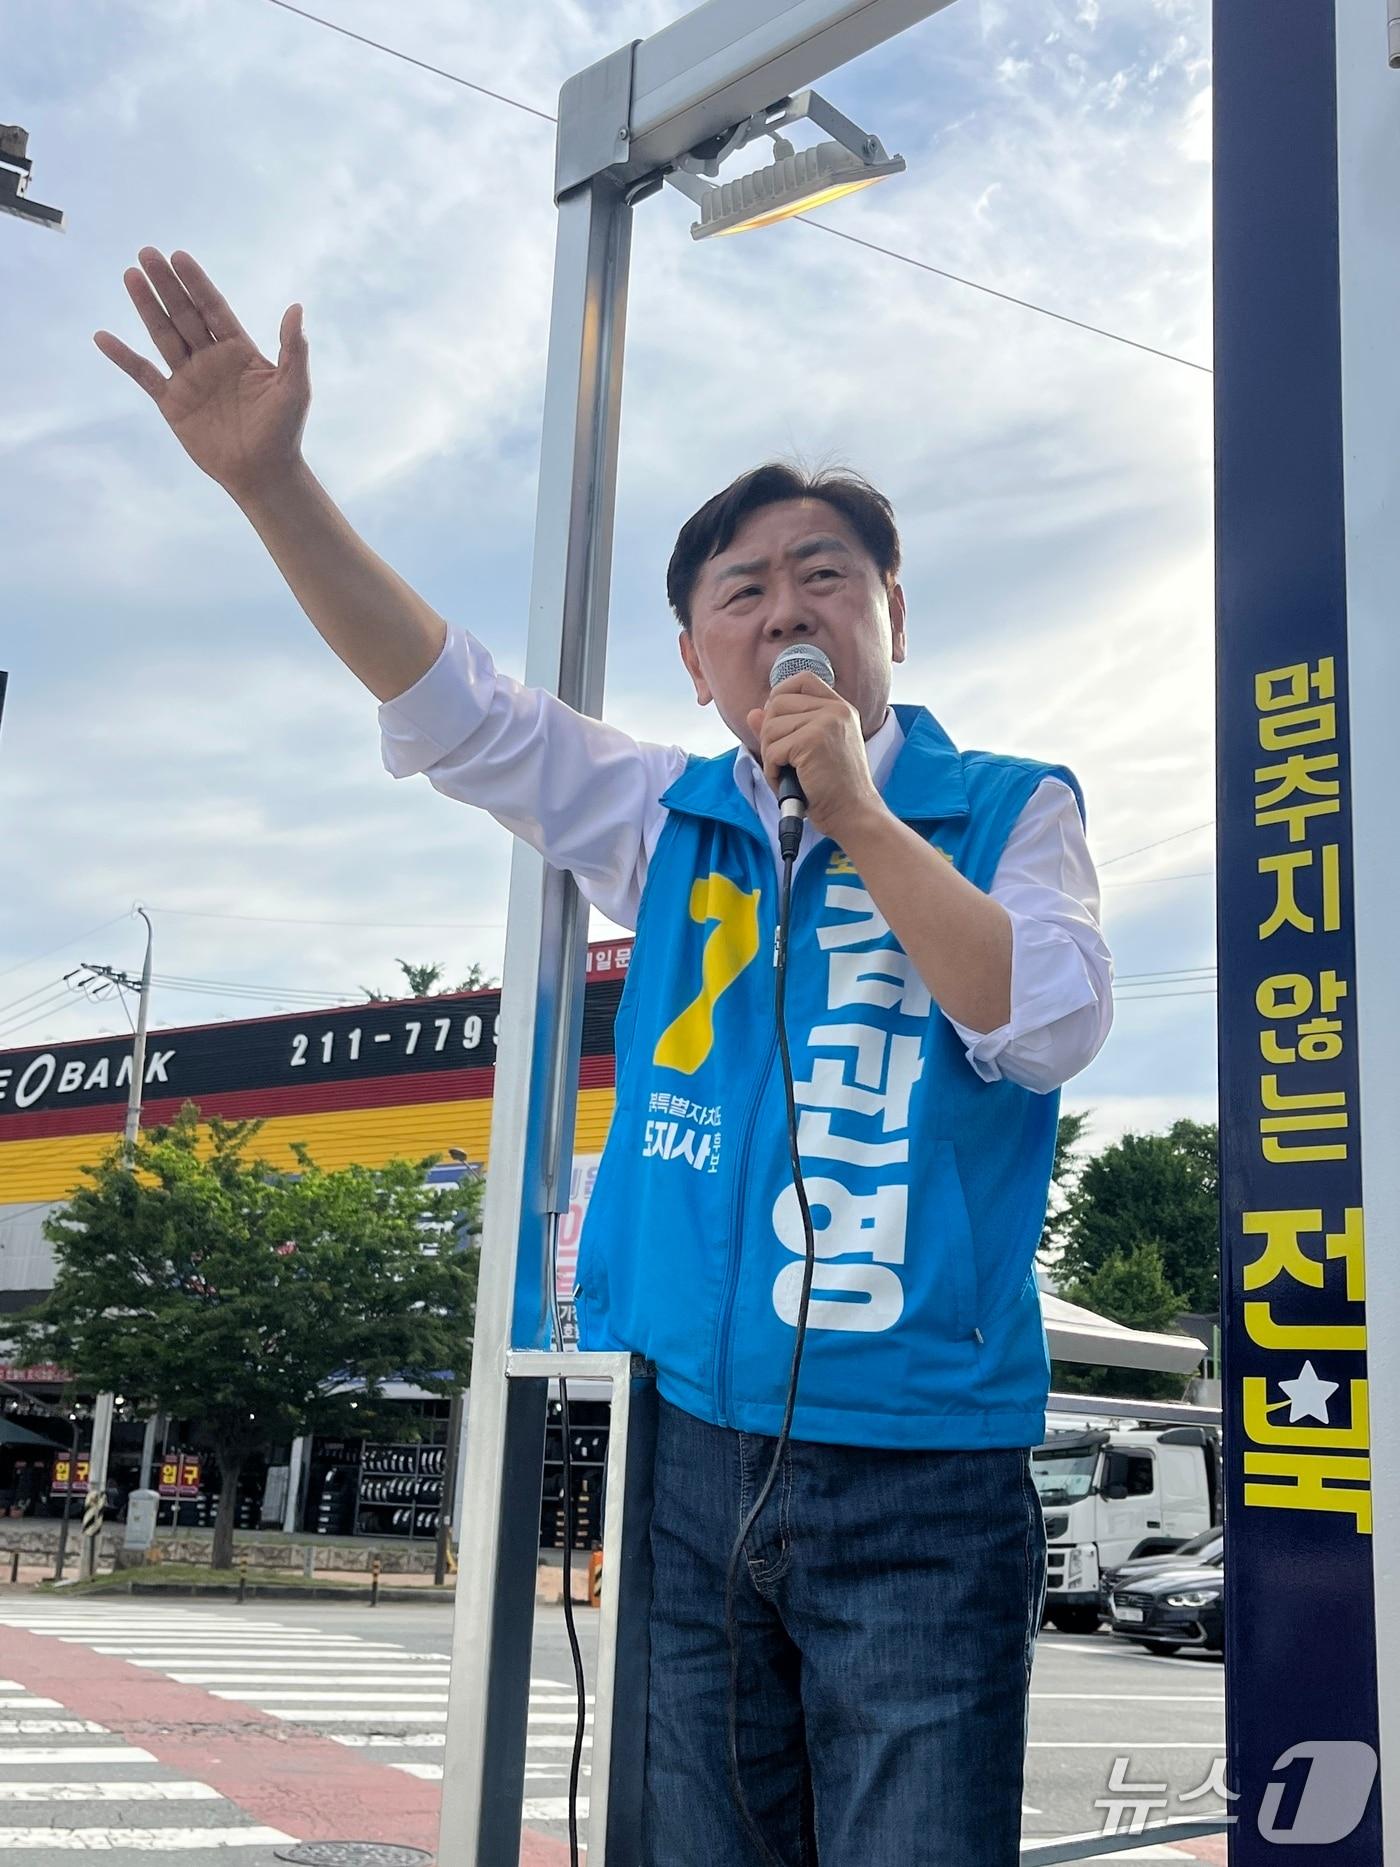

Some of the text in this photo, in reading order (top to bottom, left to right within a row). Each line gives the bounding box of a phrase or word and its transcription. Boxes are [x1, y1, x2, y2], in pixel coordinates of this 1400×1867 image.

[586, 948, 631, 972] 일문
[1242, 656, 1373, 1534] 멈추지 않는 전북
[55, 1462, 89, 1481] 입구
[162, 1465, 198, 1484] 입구
